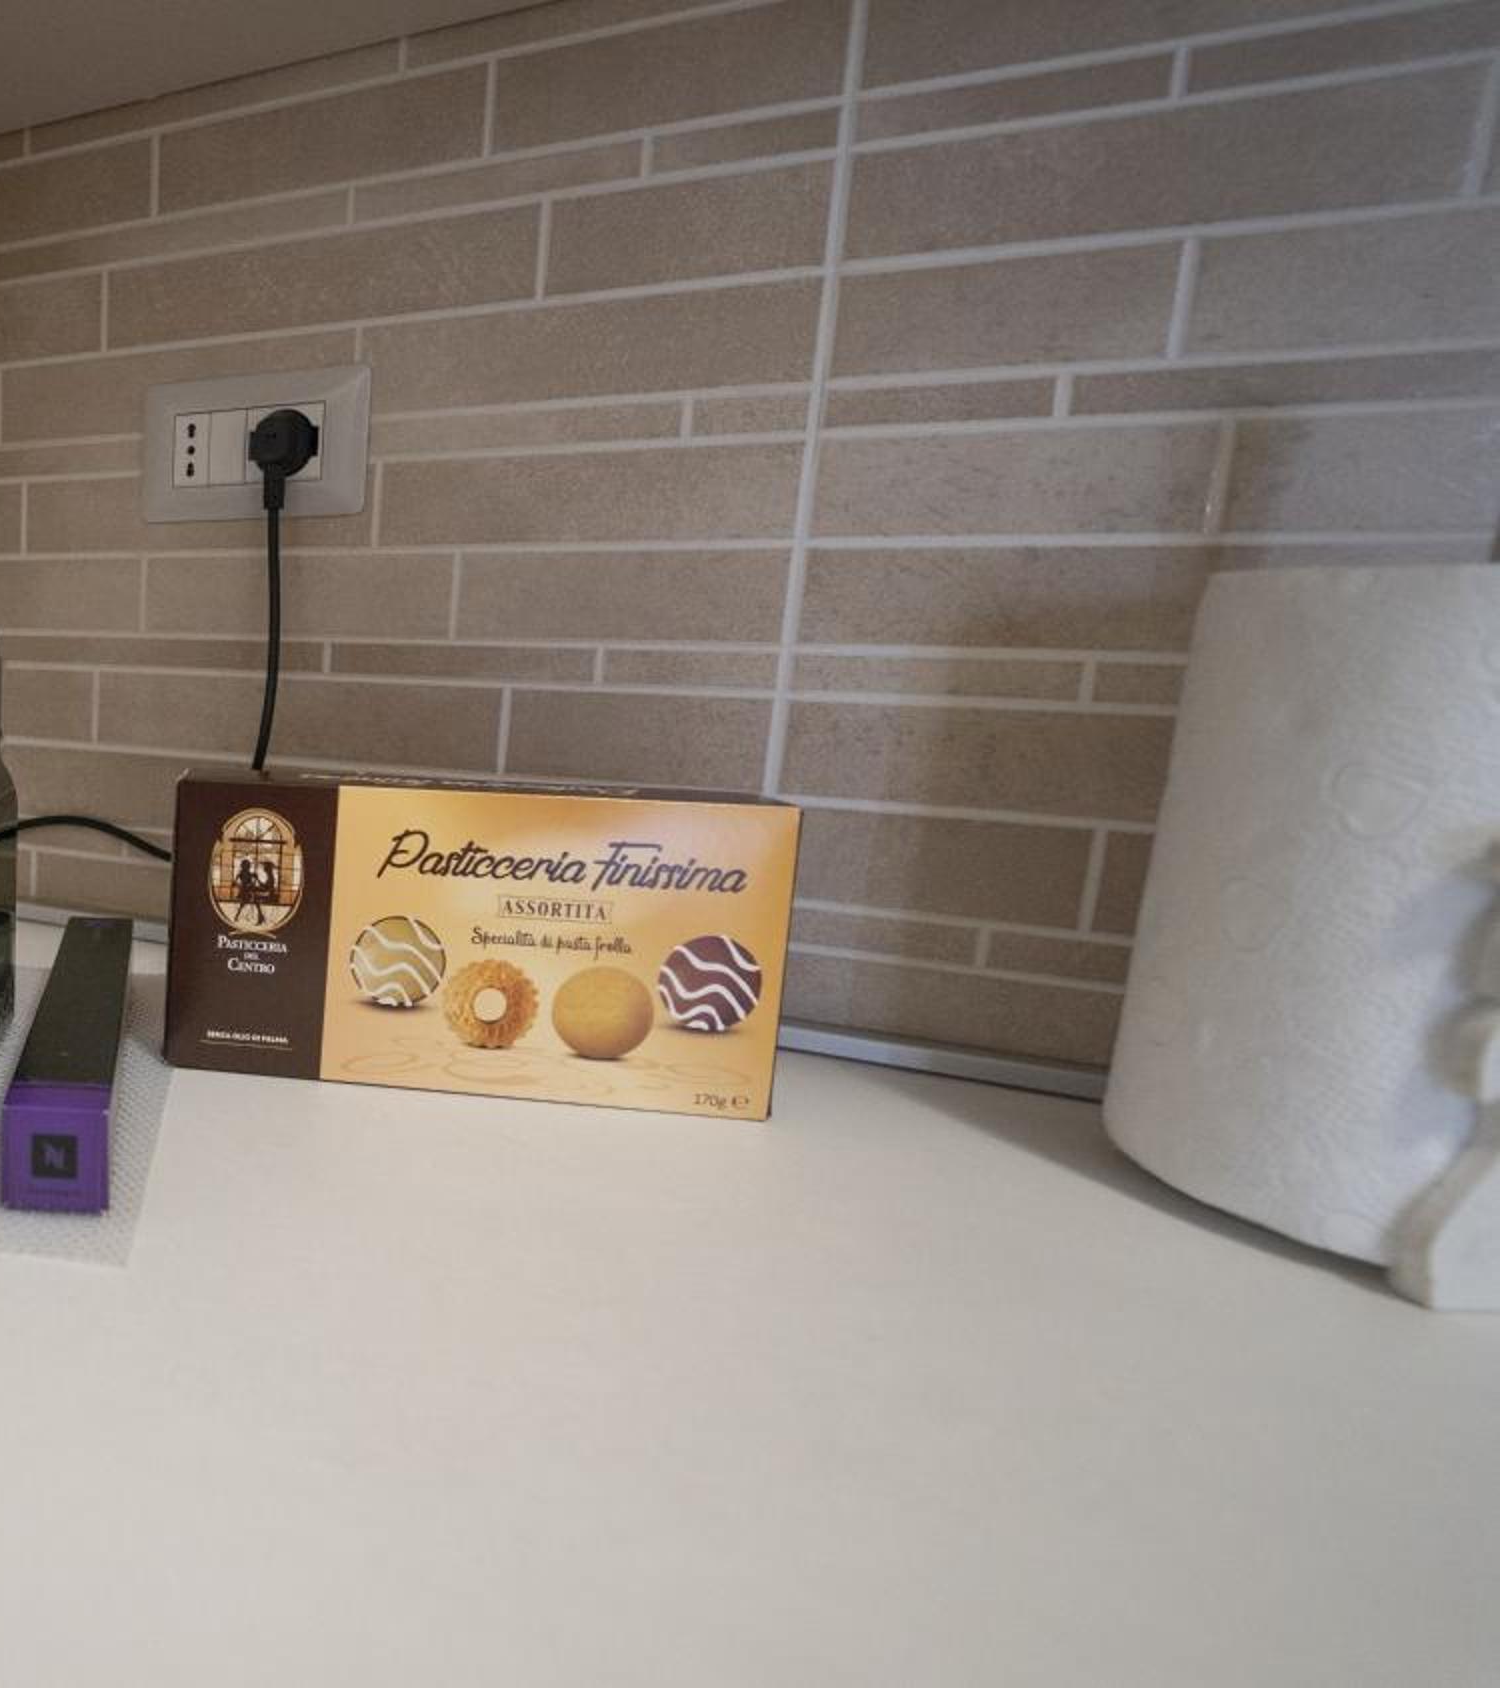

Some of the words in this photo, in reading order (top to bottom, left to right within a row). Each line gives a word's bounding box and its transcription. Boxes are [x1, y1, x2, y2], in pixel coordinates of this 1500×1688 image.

[376, 829, 587, 885] Pasticceria
[590, 841, 749, 894] Finissima
[503, 899, 606, 921] ASSORTITA
[217, 934, 288, 952] PASTICCERIA
[556, 934, 592, 955] pasta
[227, 957, 275, 974] CENTRO
[694, 1093, 727, 1110] 170g
